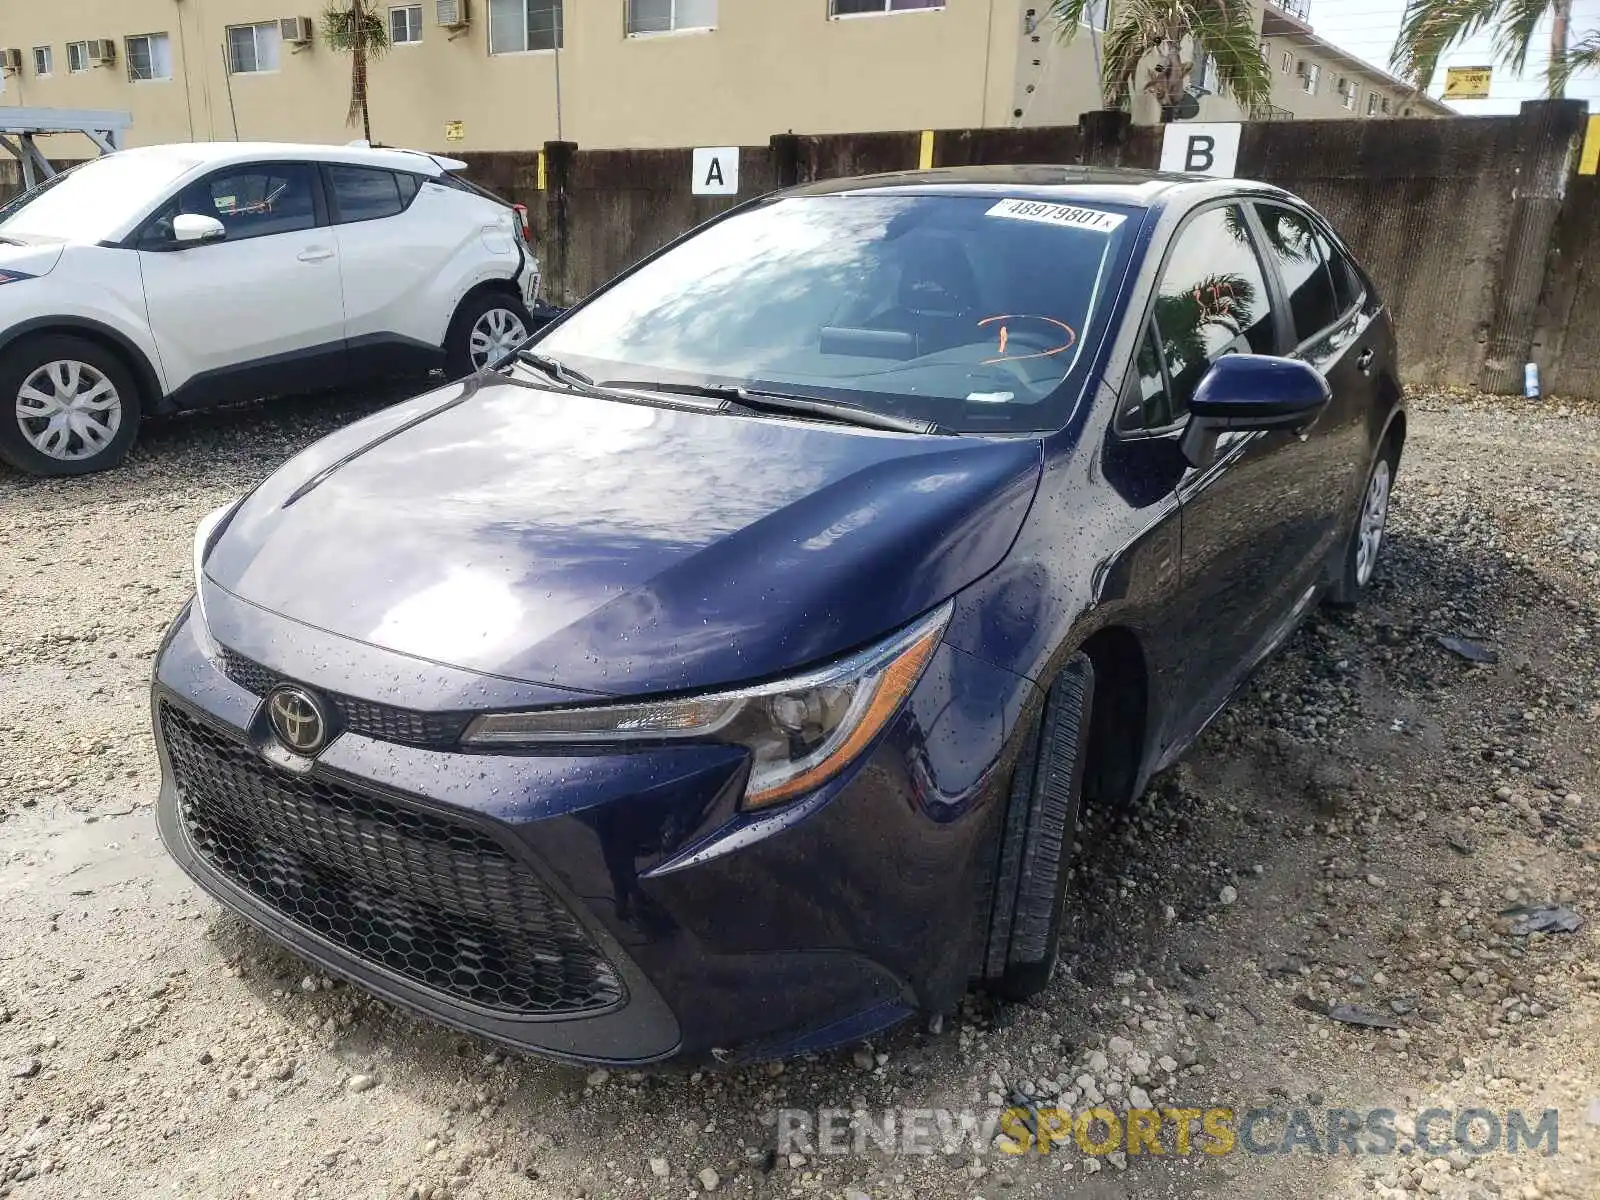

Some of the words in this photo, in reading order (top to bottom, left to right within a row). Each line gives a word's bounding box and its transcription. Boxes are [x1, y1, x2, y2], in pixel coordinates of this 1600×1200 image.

[1184, 135, 1215, 172] B
[705, 157, 724, 186] A
[1008, 201, 1106, 226] 48979801
